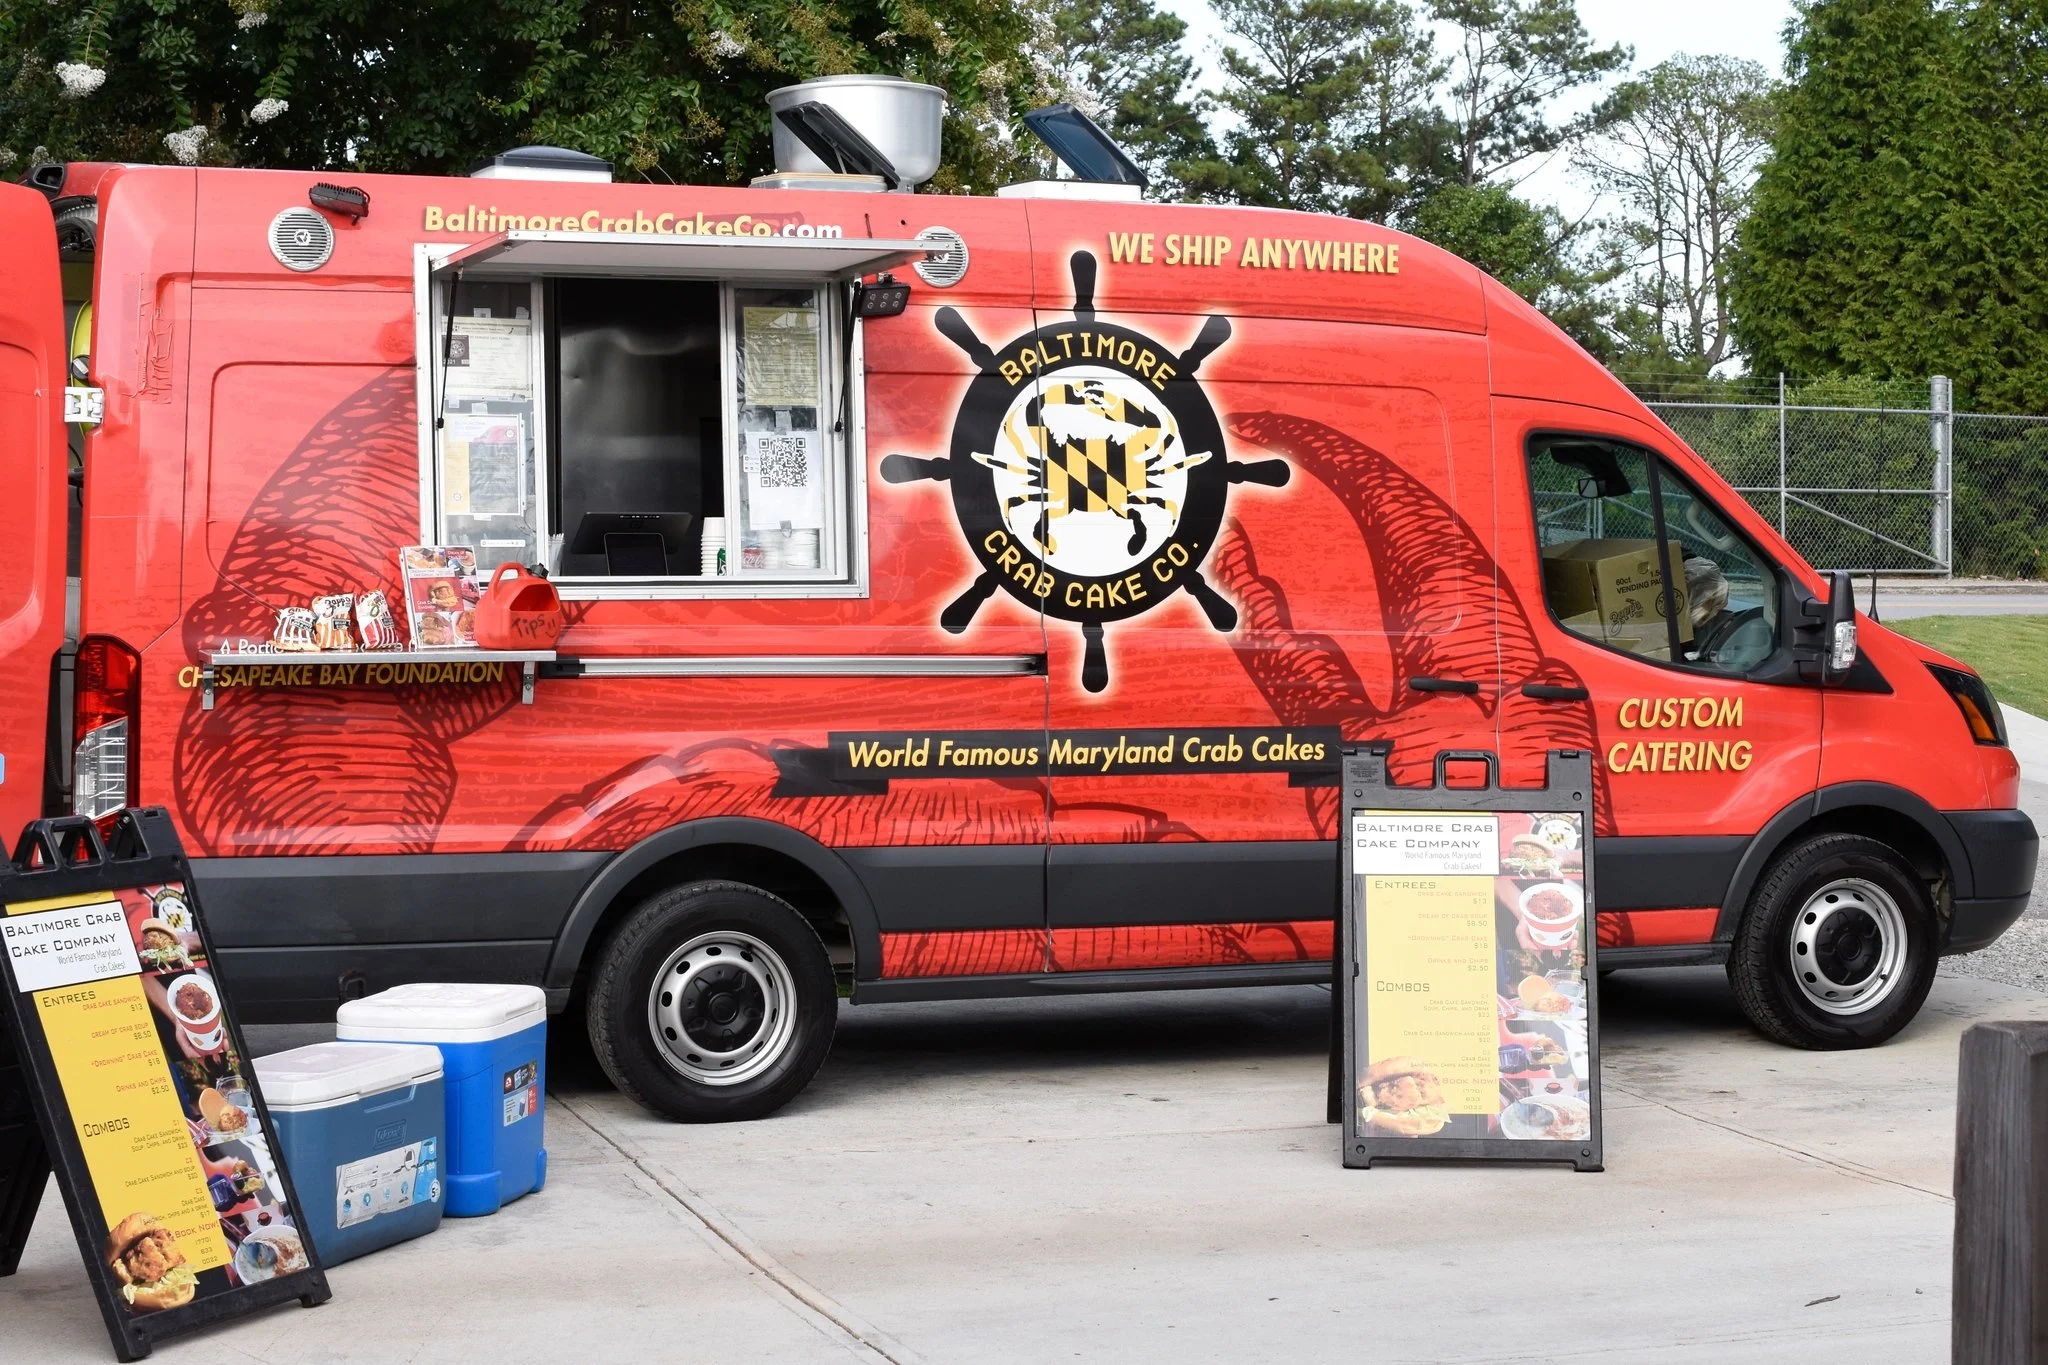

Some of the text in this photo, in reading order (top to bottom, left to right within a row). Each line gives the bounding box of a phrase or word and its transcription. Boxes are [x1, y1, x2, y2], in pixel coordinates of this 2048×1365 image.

[1108, 231, 1399, 274] WE SHIP ANYWHERE
[999, 332, 1176, 391] BALTIMORE
[984, 530, 1199, 608] CRAB CAKE CO.
[1616, 581, 1649, 595] VENDING
[511, 613, 544, 640] Tips
[320, 663, 360, 685] BAY
[365, 662, 504, 684] FOUNDATION
[1619, 697, 1743, 729] CUSTOM
[848, 733, 1325, 772] World Famous Maryland Crab Cakes
[1608, 741, 1753, 772] CATERING
[1357, 823, 1493, 833] BALTIMORE CRAB
[1357, 839, 1481, 849] CAKE COMPANY
[1405, 851, 1482, 861] World Famous Maryland
[1443, 862, 1459, 870] Crab
[1375, 880, 1436, 889] ENTREES
[5, 912, 122, 938] BALTIMORE CRAB
[11, 933, 116, 958] CAKE COMPANY
[57, 947, 123, 965] World Famous Maryland
[94, 963, 108, 974] Crab
[1377, 980, 1430, 992] COMBOS
[43, 990, 96, 1008] ENTREES
[131, 1004, 143, 1012] $13
[134, 1030, 152, 1040] $8.50
[116, 1083, 137, 1093] DRINKS
[152, 1084, 169, 1095] $2.50
[83, 1117, 130, 1138] COMBOS
[175, 1221, 220, 1238] BOOK NOW!
